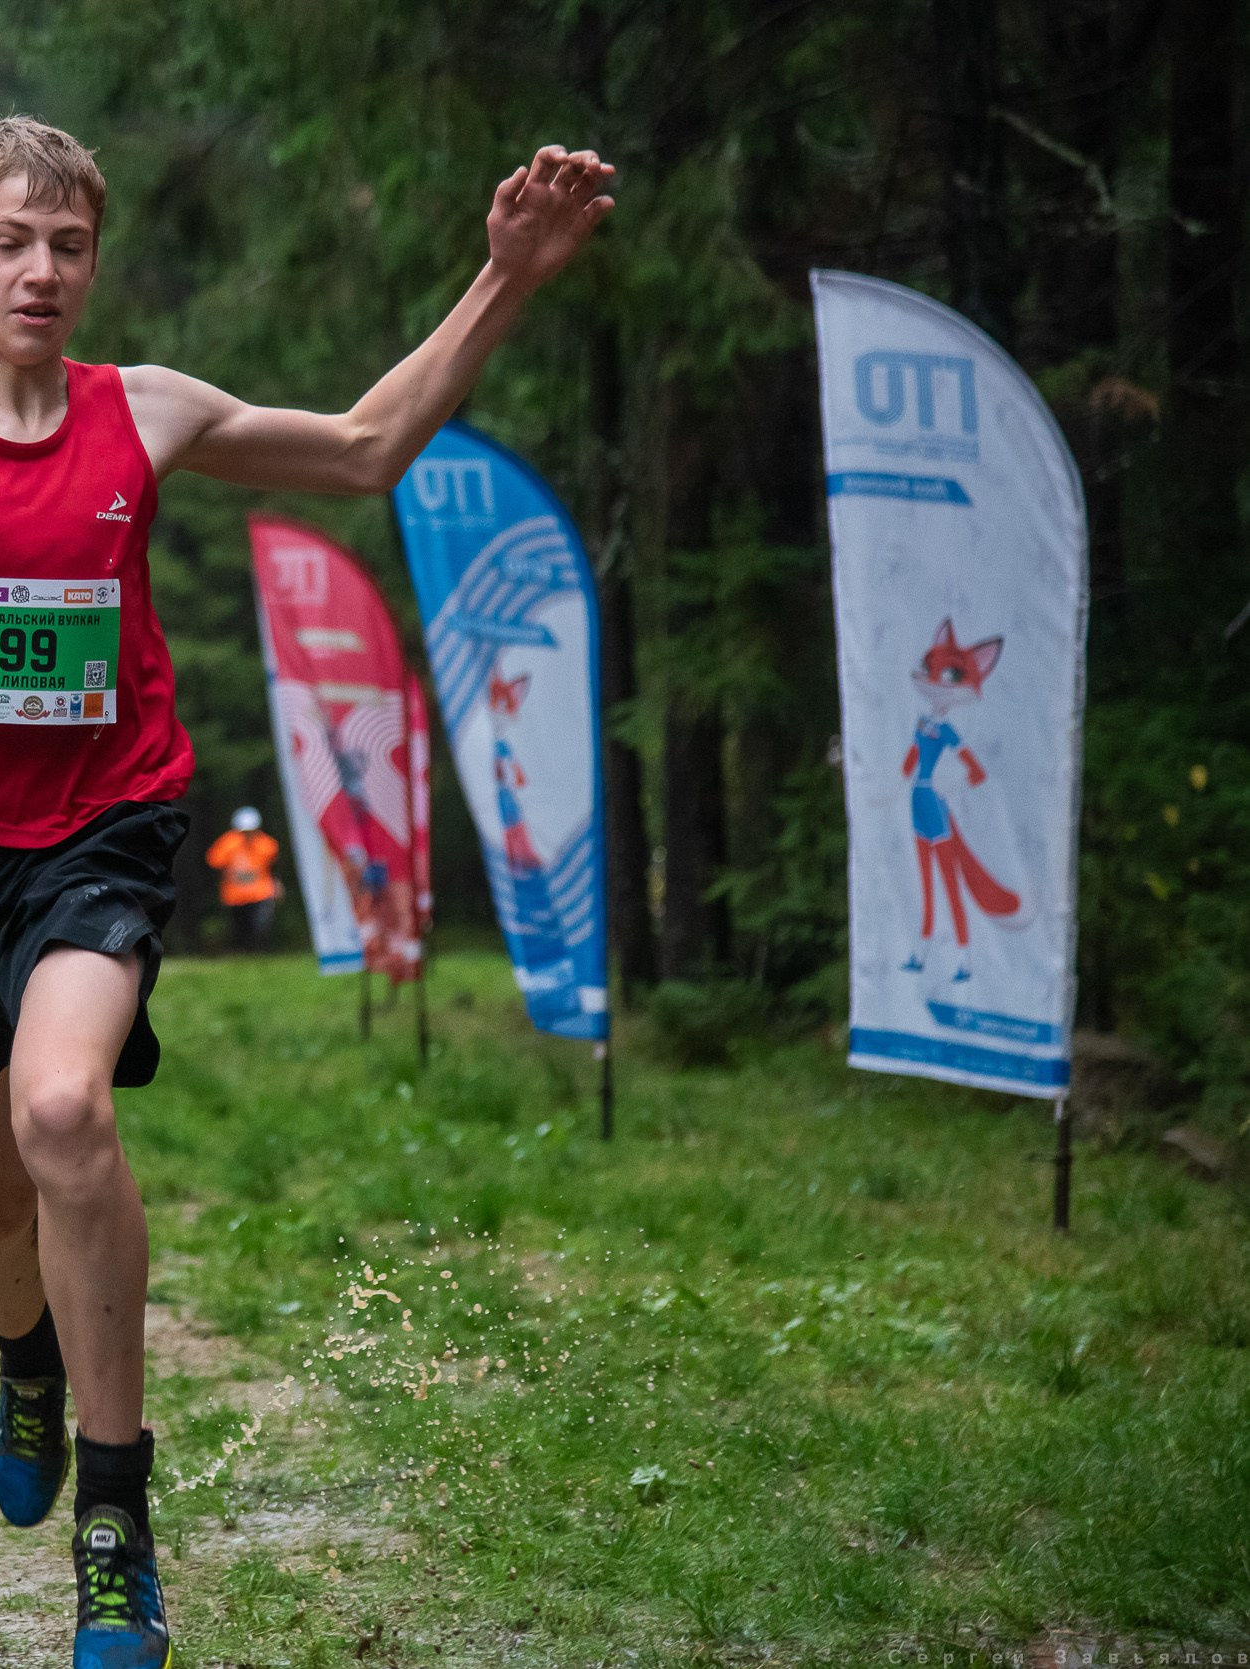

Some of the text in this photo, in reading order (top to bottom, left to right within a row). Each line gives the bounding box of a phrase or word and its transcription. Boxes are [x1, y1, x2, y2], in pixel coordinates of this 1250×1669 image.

[96, 511, 132, 523] DEMIX
[58, 614, 101, 626] ВУЛКАН
[0, 628, 58, 673] 99
[1, 675, 66, 689] ЛИПОВАЯ
